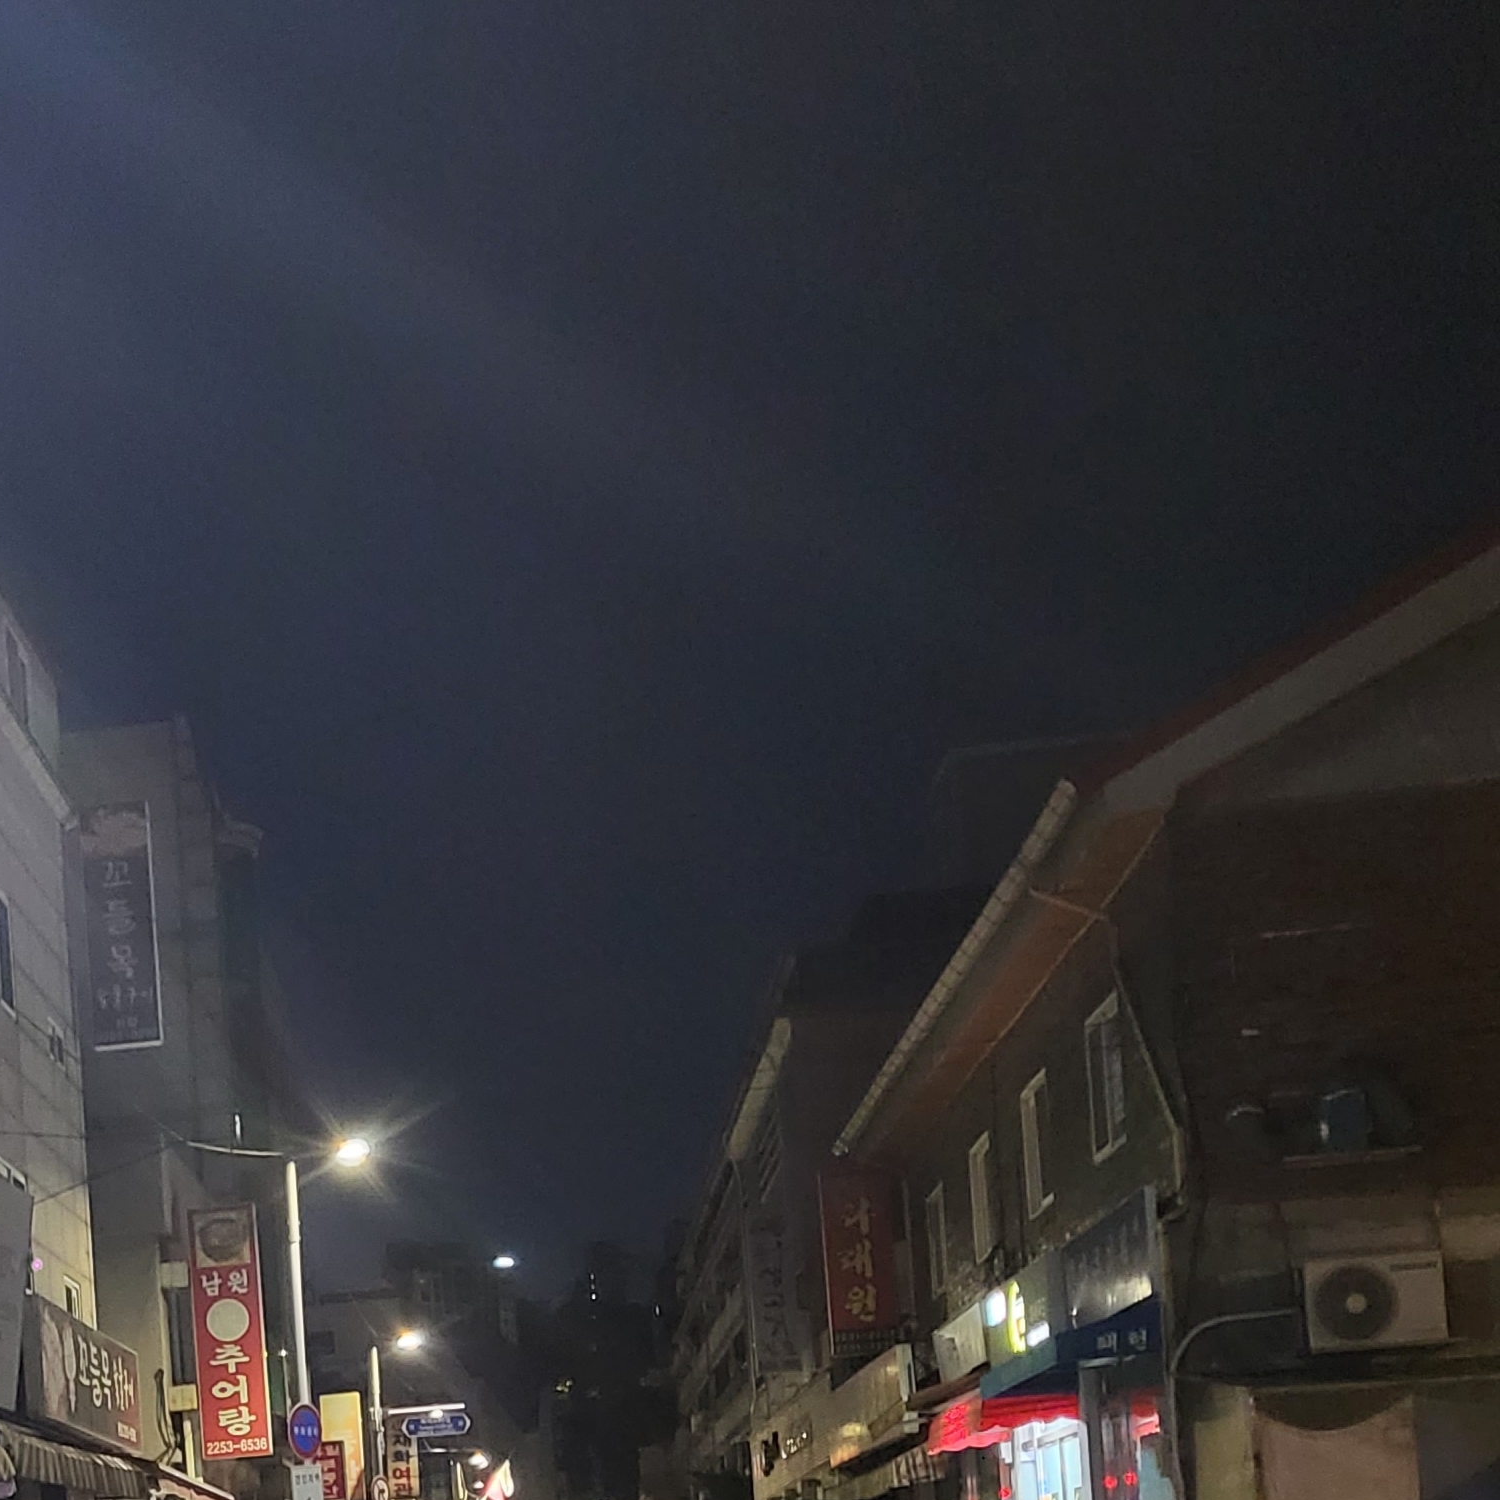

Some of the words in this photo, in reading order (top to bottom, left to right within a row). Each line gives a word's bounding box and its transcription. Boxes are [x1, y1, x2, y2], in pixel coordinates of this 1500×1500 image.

[200, 1269, 250, 1297] 남원
[209, 1343, 258, 1437] 추어탕
[206, 1436, 268, 1455] 2253-6536
